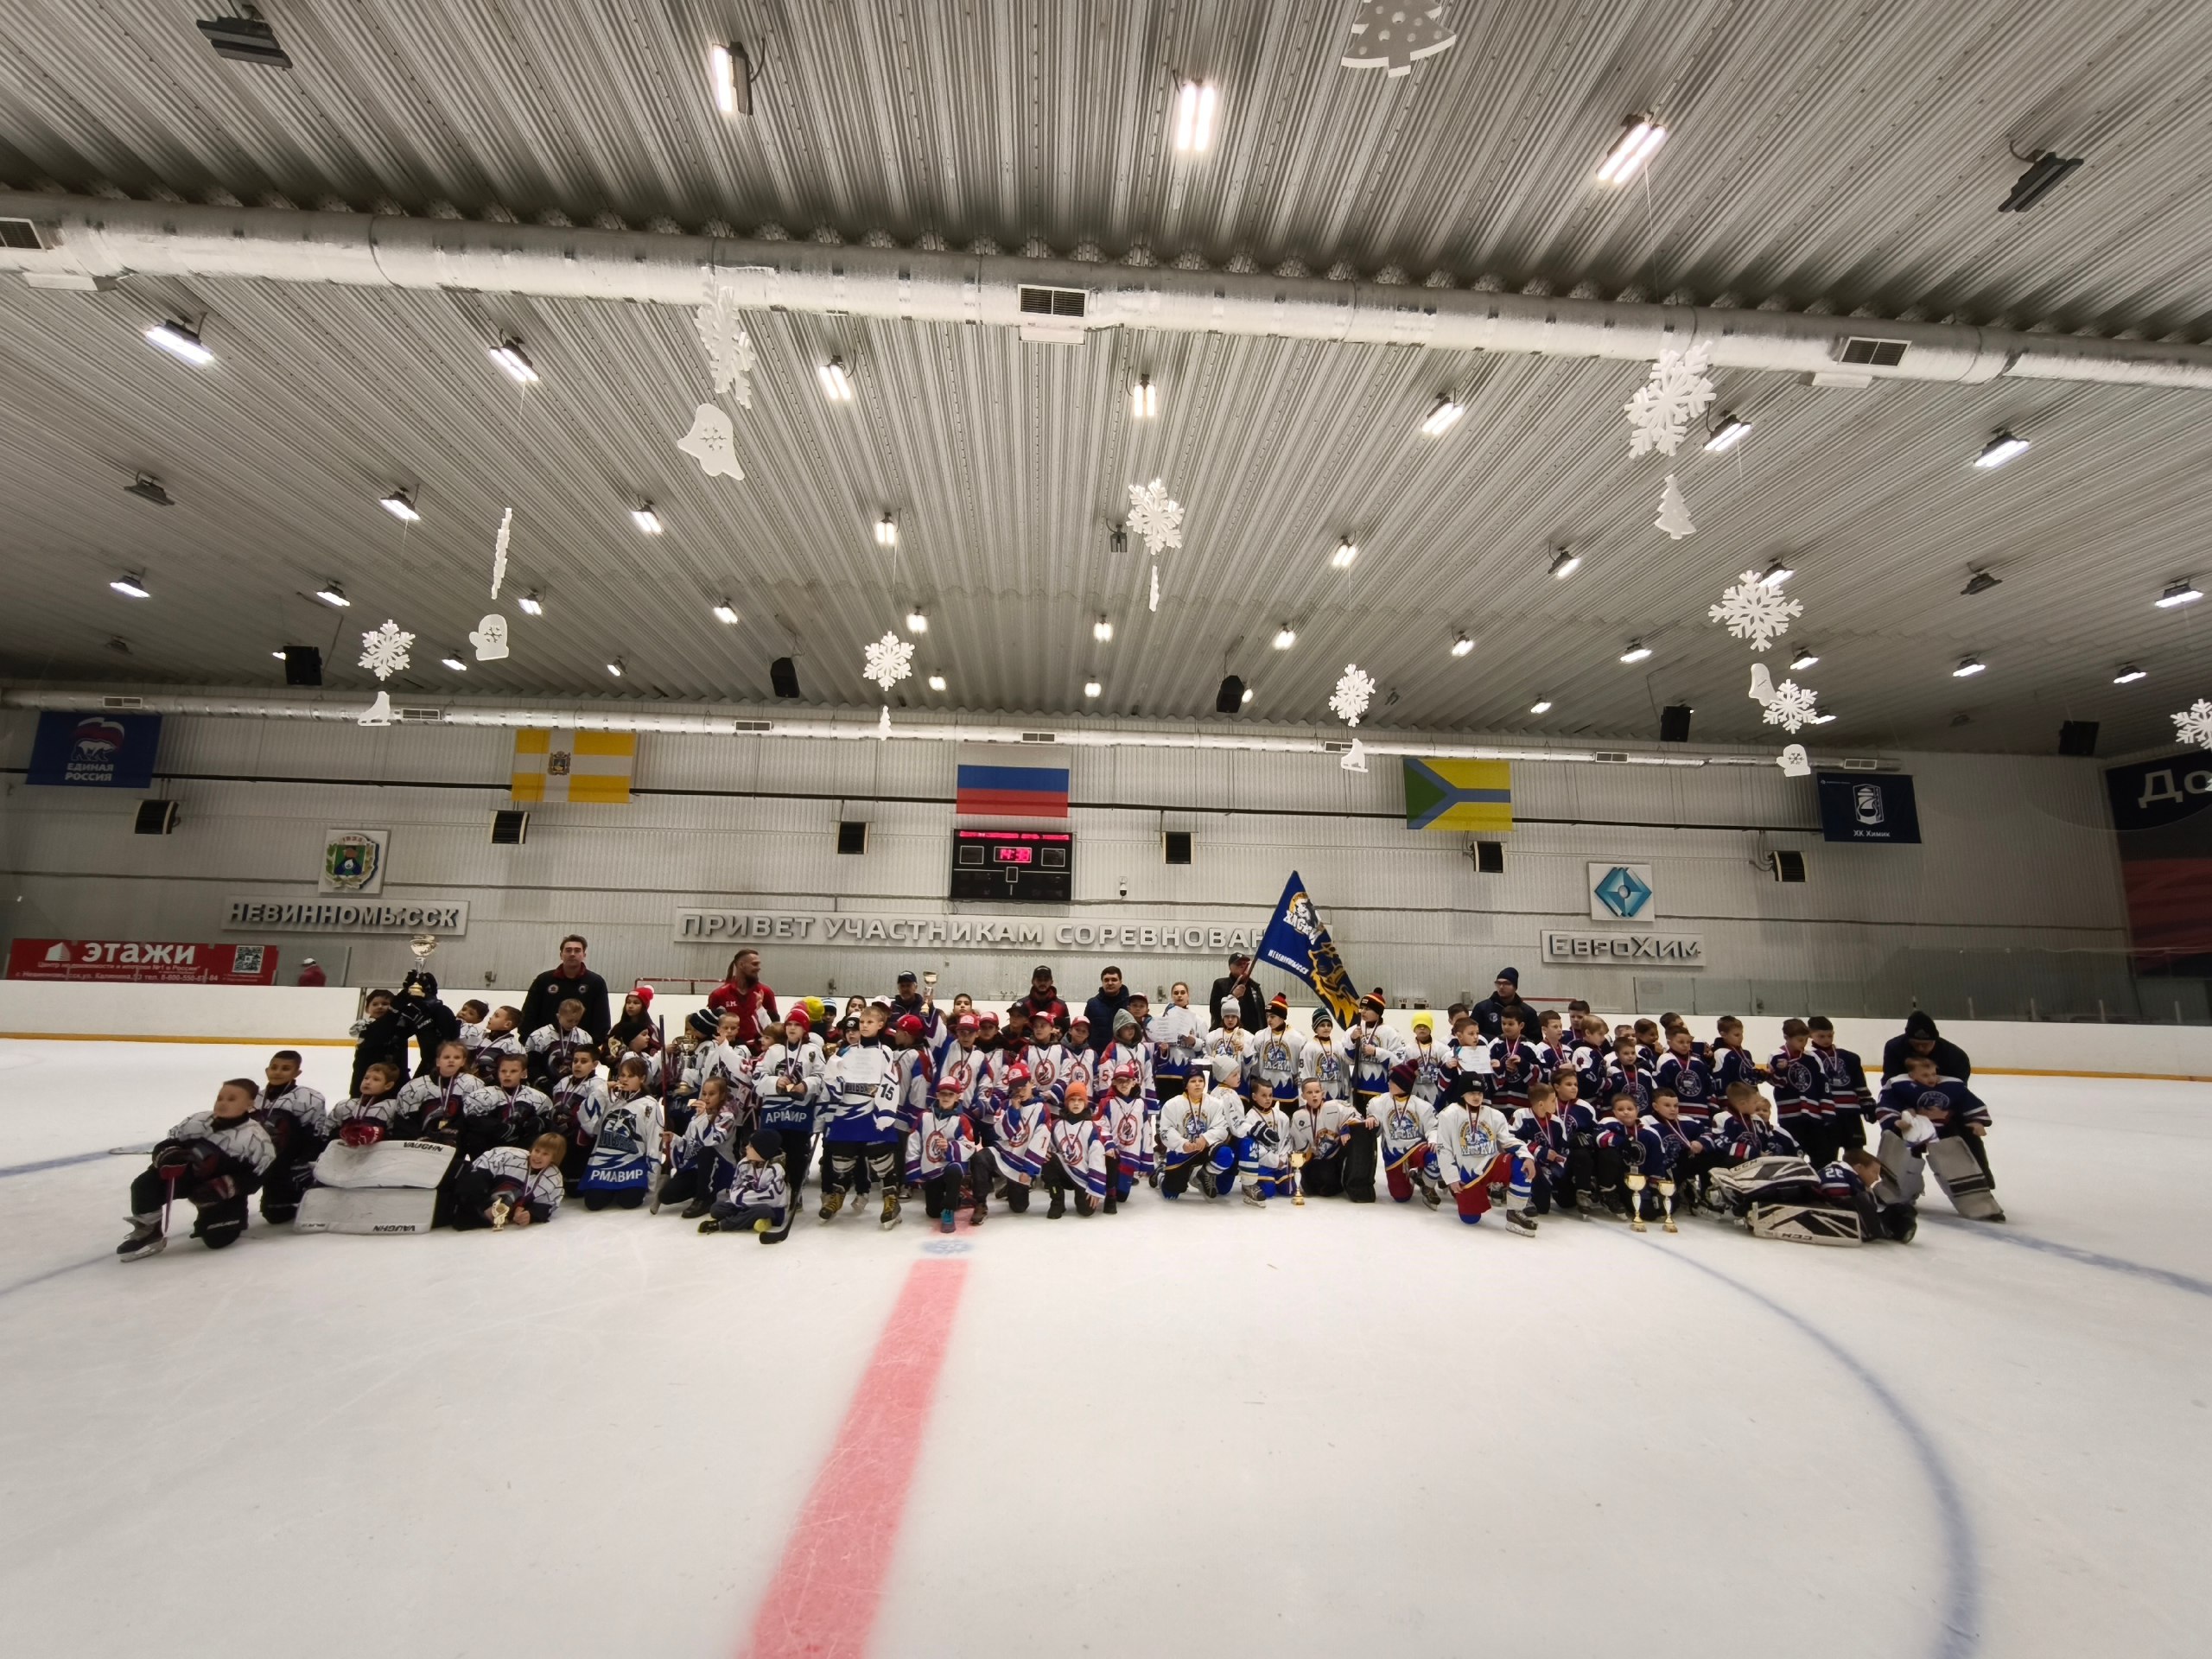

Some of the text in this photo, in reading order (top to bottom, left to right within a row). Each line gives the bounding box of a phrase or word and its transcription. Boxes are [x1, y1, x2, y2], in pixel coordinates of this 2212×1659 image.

[67, 762, 115, 772] ЕДИНАЯ
[65, 772, 112, 782] РОССИЯ
[229, 903, 460, 928] НЕВИННОМЫССК
[680, 913, 1267, 949] ПРИВЕТ УЧАСТНИКАМ СОРЕВНОВАН
[880, 1083, 894, 1102] 15
[403, 1141, 444, 1153] VAUGHN
[1733, 1159, 1758, 1172] CCM
[588, 1168, 644, 1183] РМАВИР
[1782, 1232, 1813, 1241] CCM
